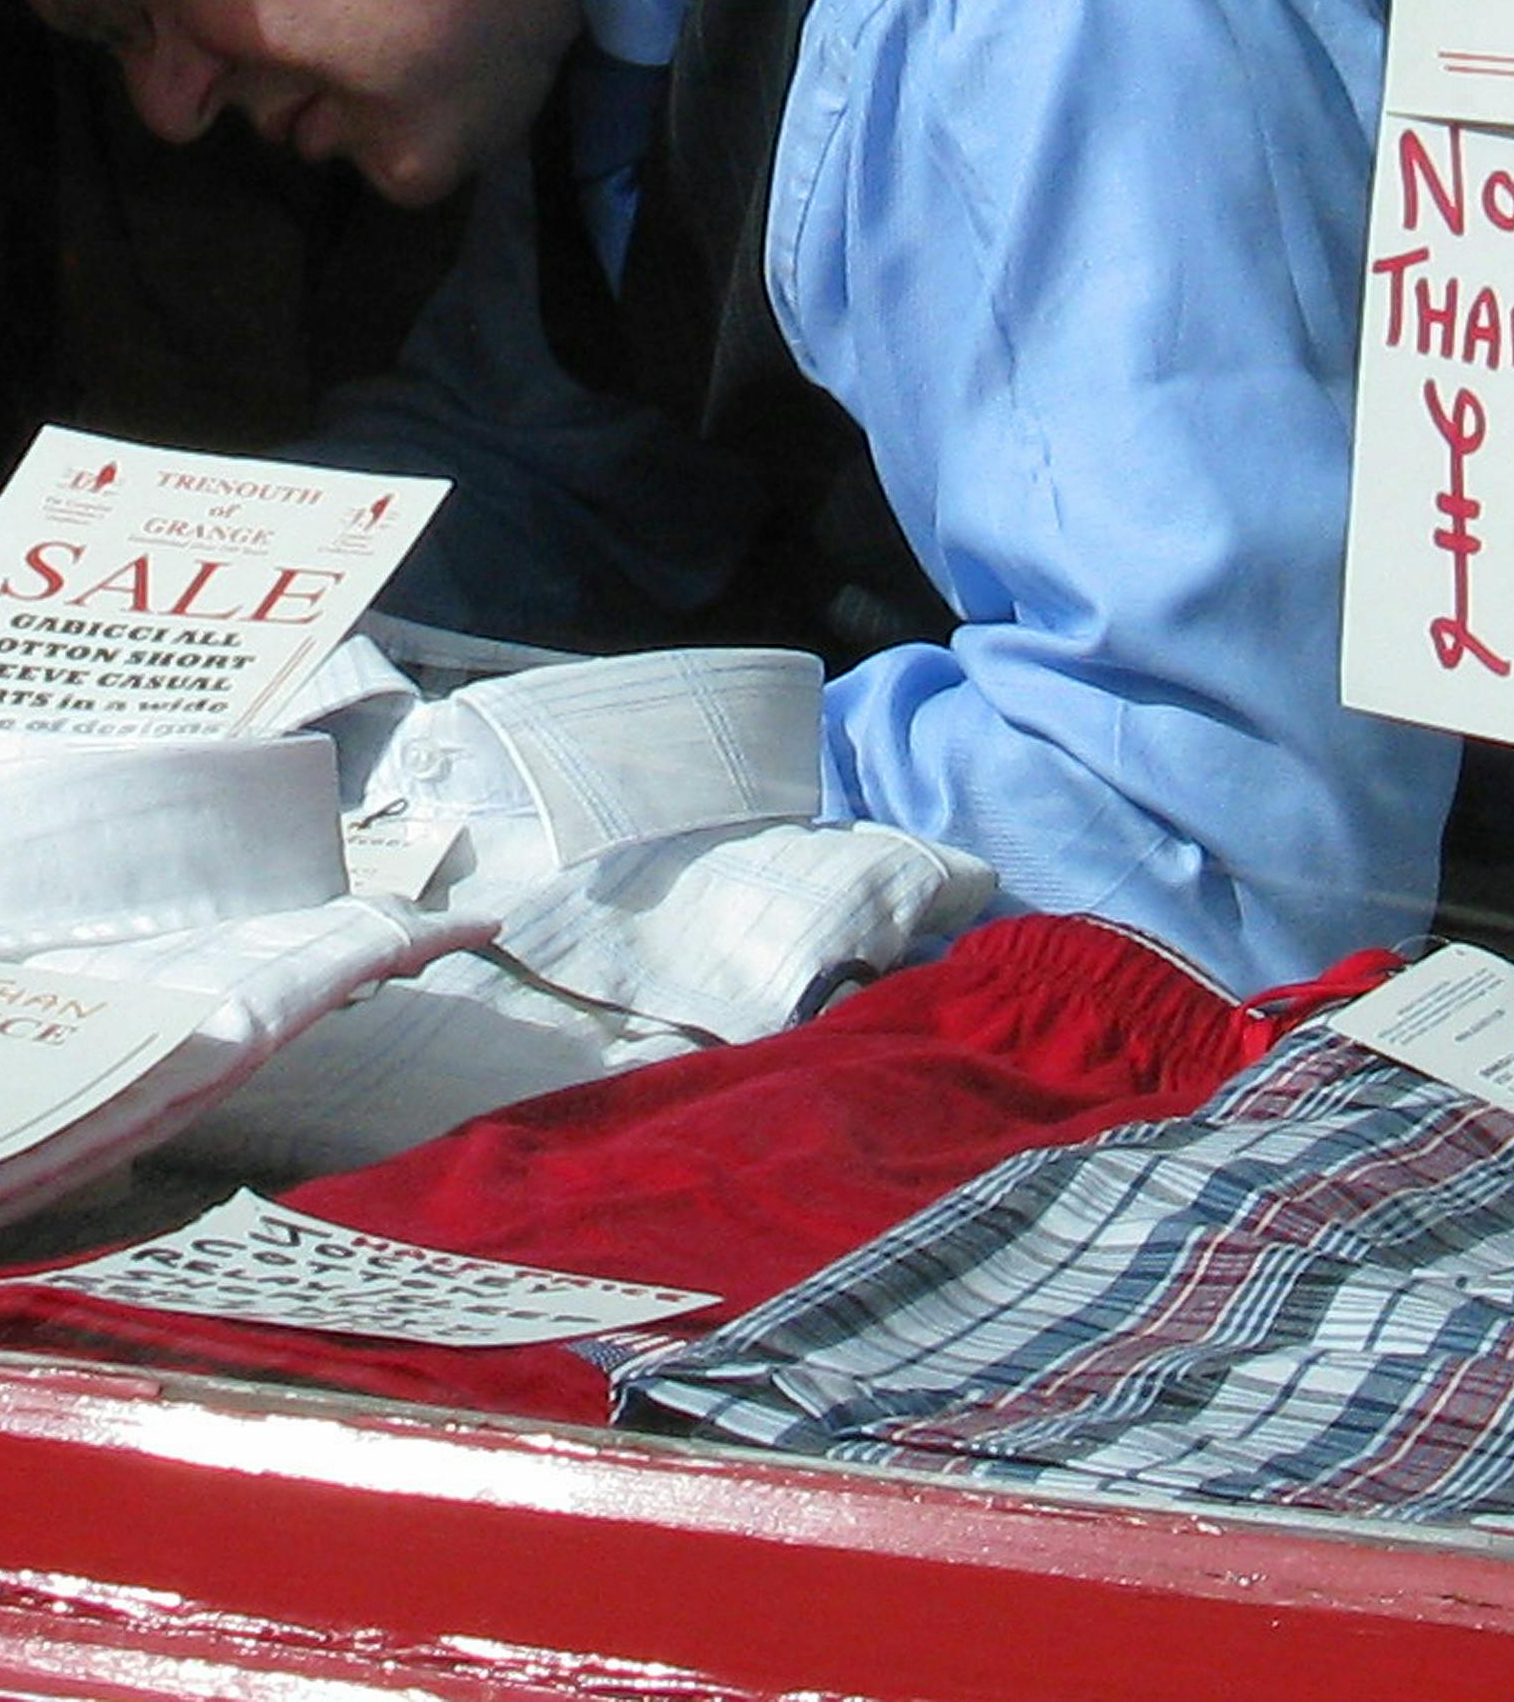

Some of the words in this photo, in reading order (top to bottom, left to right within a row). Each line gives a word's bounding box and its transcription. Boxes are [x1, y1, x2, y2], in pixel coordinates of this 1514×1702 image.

[155, 469, 326, 507] TRENOUTH
[207, 499, 238, 520] of
[141, 515, 277, 548] GRANGE
[170, 629, 243, 648] ALL
[123, 648, 258, 671] SHORT
[96, 670, 234, 693] CASUAL
[57, 694, 94, 712] in
[137, 697, 230, 714] wide
